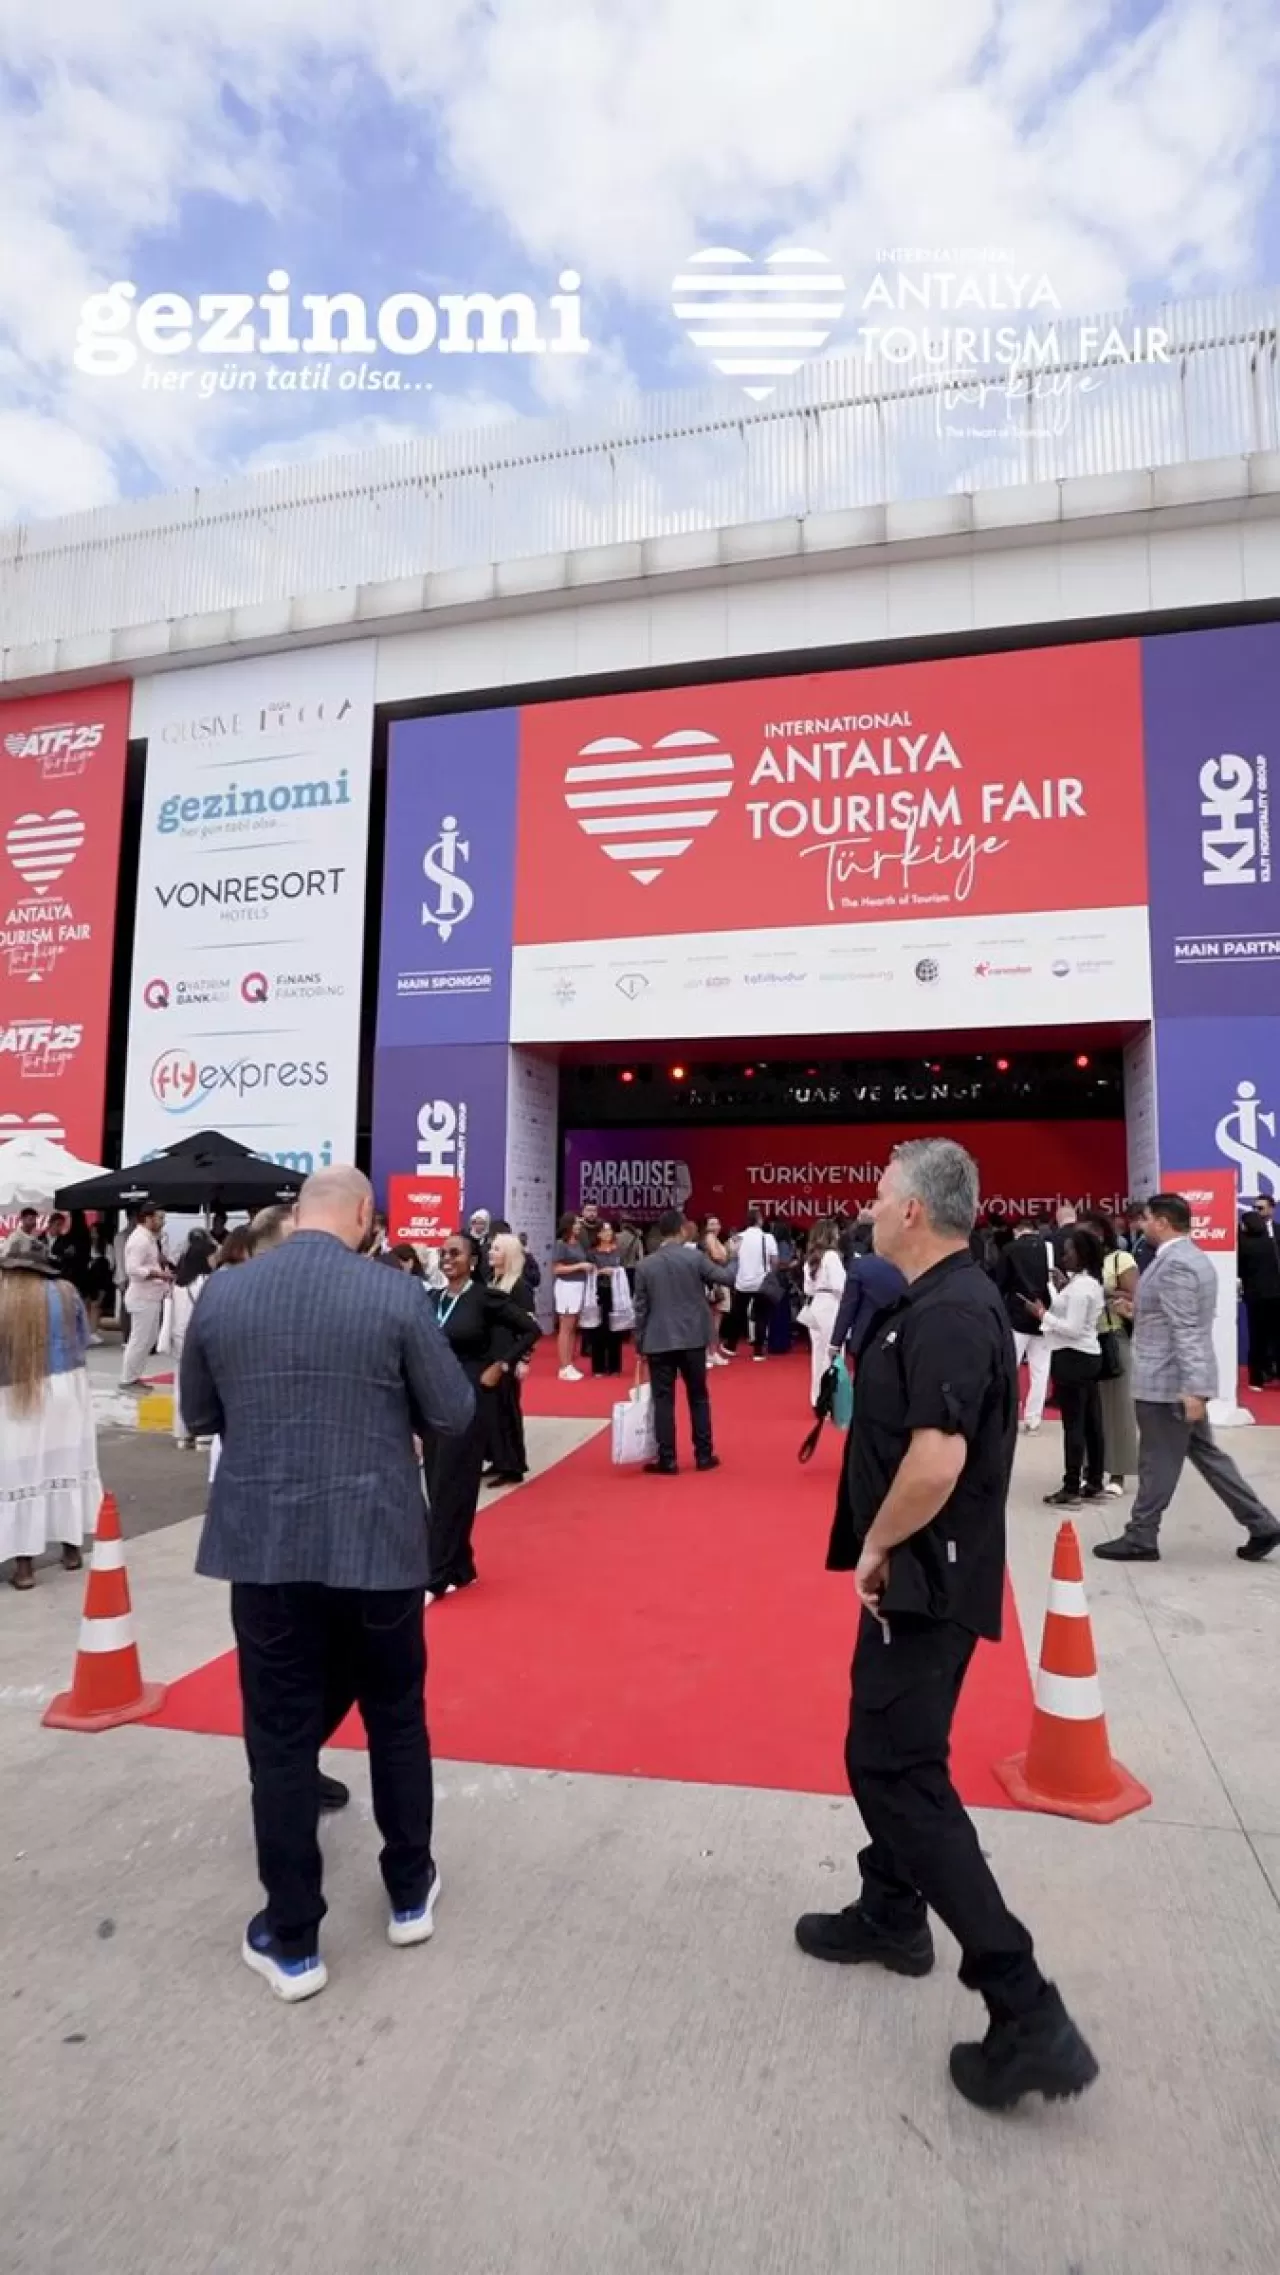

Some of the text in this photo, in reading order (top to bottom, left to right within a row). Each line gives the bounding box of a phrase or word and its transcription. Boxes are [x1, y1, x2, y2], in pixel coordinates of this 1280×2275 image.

[764, 711, 912, 737] INTERNATIONAL
[748, 731, 962, 787] ANTALYA
[157, 768, 351, 834] gezinomi
[745, 778, 1087, 839] TOURISM FAIR
[1199, 754, 1257, 886] KHG
[799, 803, 1009, 911] Türkiye
[156, 868, 346, 909] VONRESORT
[5, 902, 73, 925] ANTALYA
[58, 923, 91, 942] FAIR
[1175, 943, 1219, 957] MAIN
[398, 974, 492, 990] MAIN SPONSOR
[416, 1099, 457, 1177] HG
[579, 1159, 675, 1186] PARADISE
[398, 1227, 452, 1238] CHECK-IN
[410, 1216, 440, 1226] SELF
